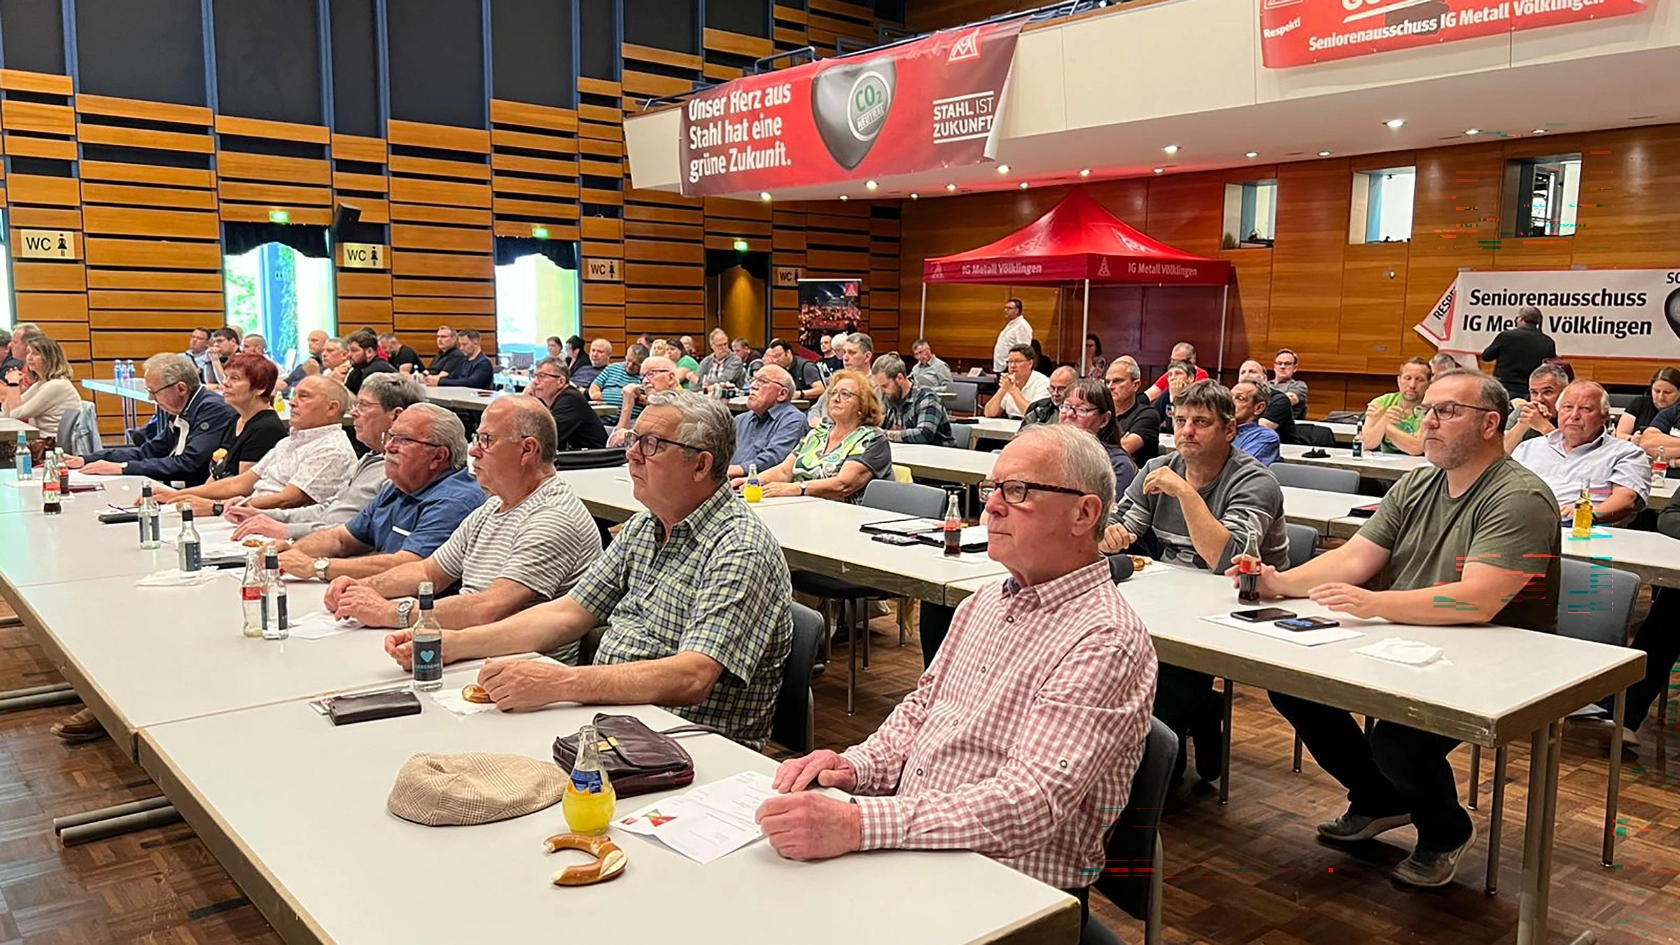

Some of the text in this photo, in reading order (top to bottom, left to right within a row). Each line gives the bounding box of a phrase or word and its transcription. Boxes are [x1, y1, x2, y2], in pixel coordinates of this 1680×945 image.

[1263, 16, 1301, 38] Respekt!
[1309, 0, 1605, 51] Seniorenausschuss IG Metall Völkling
[688, 83, 792, 121] Unser Herz aus
[933, 97, 994, 121] STAHL IST
[689, 112, 782, 150] Stahl hat eine
[933, 115, 993, 138] ZUKUNFT
[689, 140, 792, 183] grüne Zukunft.
[26, 236, 51, 251] WC
[347, 249, 366, 262] WC
[590, 263, 606, 275] WC
[779, 271, 792, 282] WC
[962, 262, 1042, 276] IG Metall Völklingen
[1128, 262, 1197, 278] IG Metall Völklingen
[1469, 288, 1647, 307] Seniorenausschuss
[1462, 314, 1482, 332] IG
[1549, 315, 1652, 339] Völklingen
